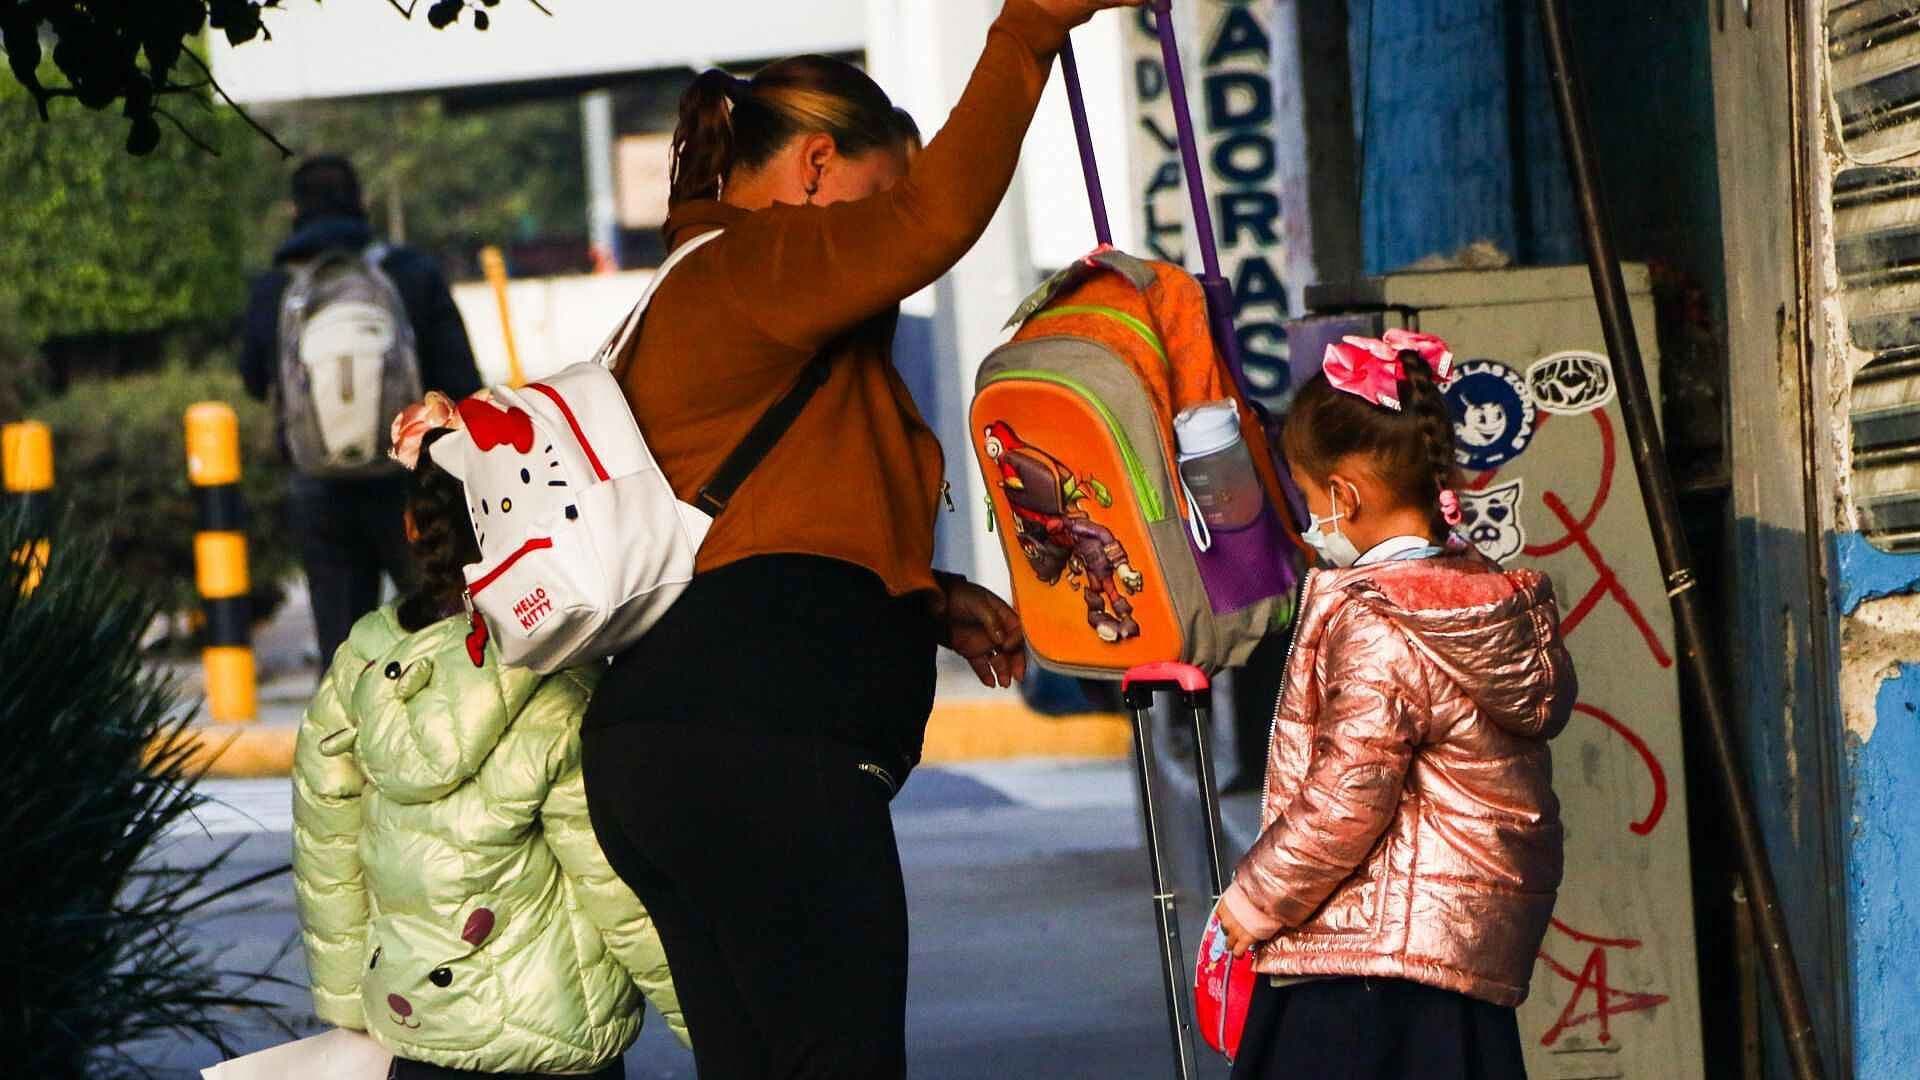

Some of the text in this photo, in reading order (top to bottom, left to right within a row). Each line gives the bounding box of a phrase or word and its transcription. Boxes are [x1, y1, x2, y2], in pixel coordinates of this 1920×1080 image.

[1463, 362, 1504, 376] LAS
[513, 587, 546, 617] HELLO
[520, 599, 553, 630] KITTY
